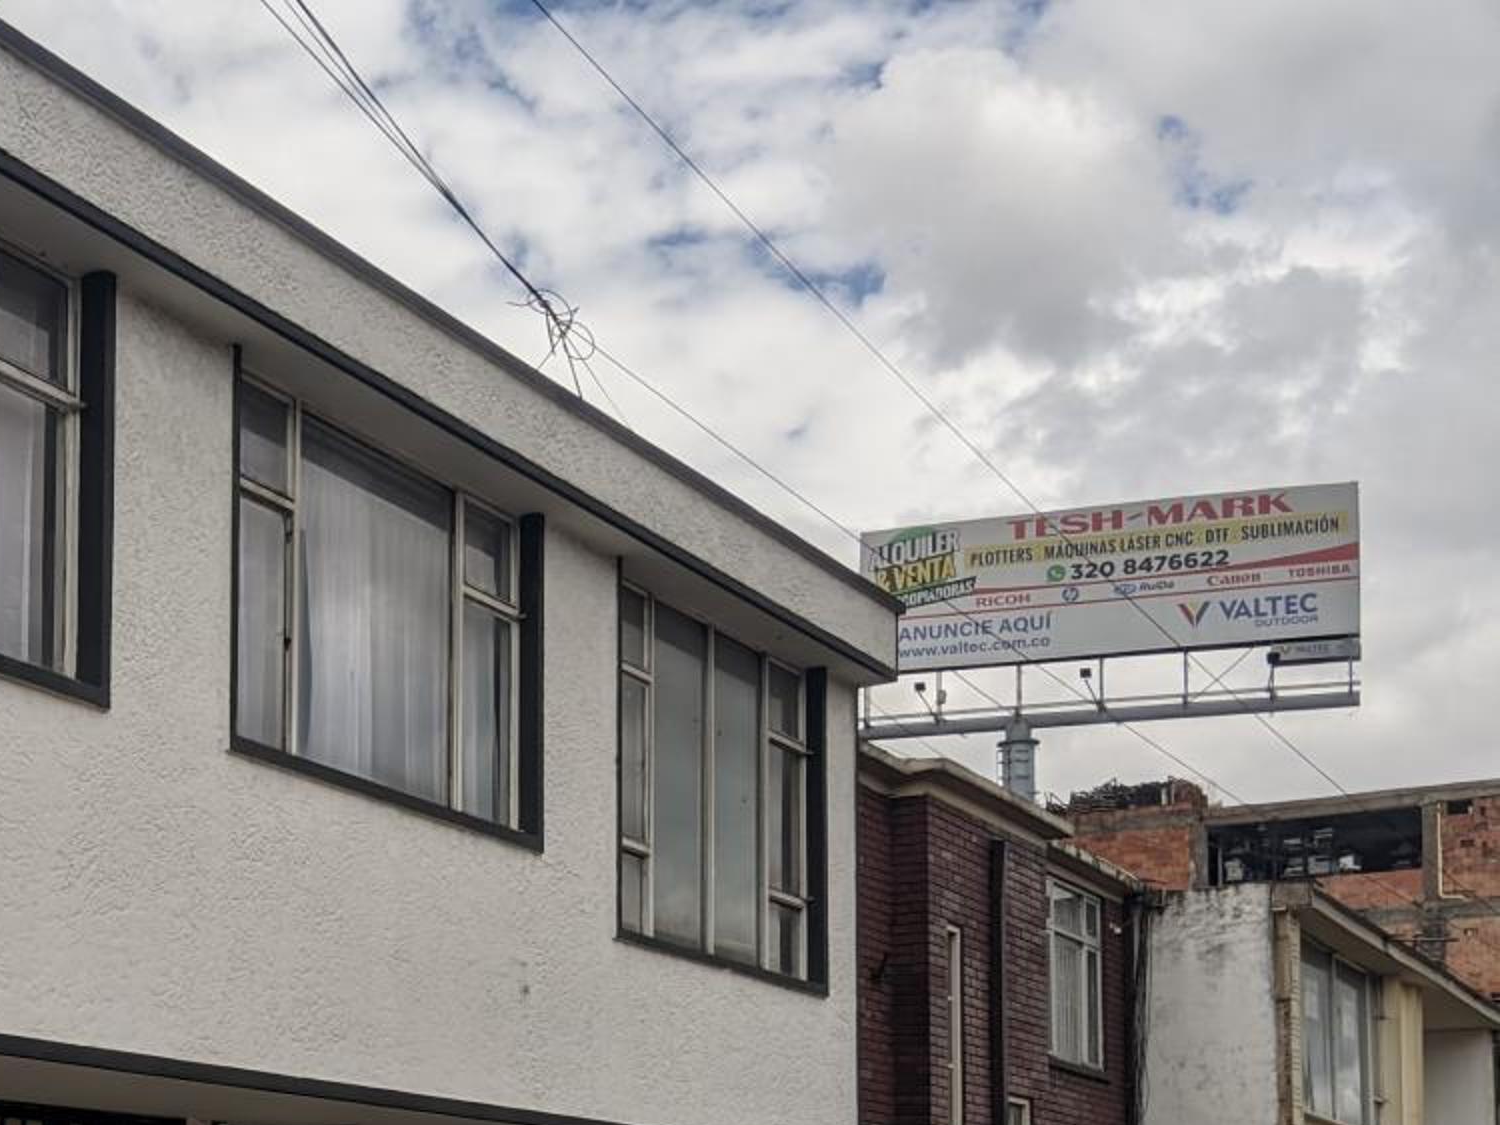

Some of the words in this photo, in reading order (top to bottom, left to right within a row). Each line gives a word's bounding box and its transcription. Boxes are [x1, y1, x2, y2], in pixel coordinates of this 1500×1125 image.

[1007, 494, 1292, 540] TESH-MARK
[970, 547, 1033, 567] PLOTTERS
[1165, 532, 1194, 547] CNC
[1205, 527, 1230, 543] DTF
[1241, 513, 1339, 540] SUBLIMACIÓN
[893, 554, 955, 591] VENTA
[1070, 561, 1115, 580] 320
[1123, 550, 1229, 575] 8476622
[976, 592, 1030, 608] RICOH
[1289, 563, 1351, 578] TOSHIBA
[1220, 592, 1318, 620] VALTEC
[1255, 614, 1318, 628] OUTDOOR
[900, 619, 993, 642] ANUNCIE
[999, 611, 1052, 634] AQUÍ
[900, 636, 1050, 658] www.valtec.com.co
